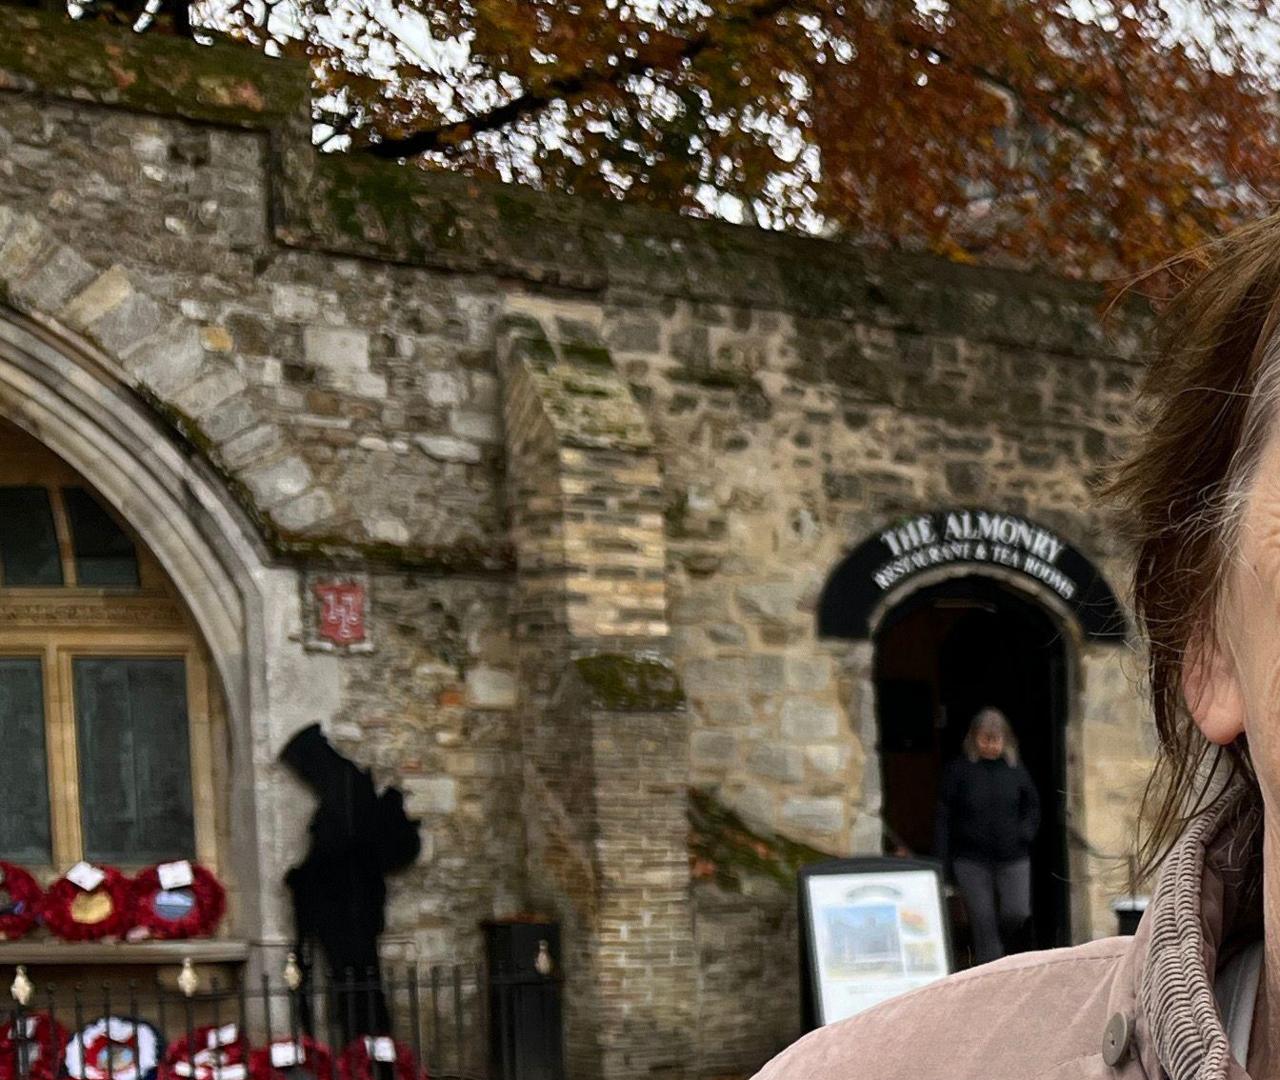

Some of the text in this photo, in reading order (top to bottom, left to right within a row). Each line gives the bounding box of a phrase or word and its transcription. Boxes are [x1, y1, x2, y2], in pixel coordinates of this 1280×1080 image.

[880, 511, 1064, 562] THE ALMONRY
[974, 543, 988, 560] &
[992, 545, 1020, 568] TEA
[1023, 556, 1076, 600] ROOMS
